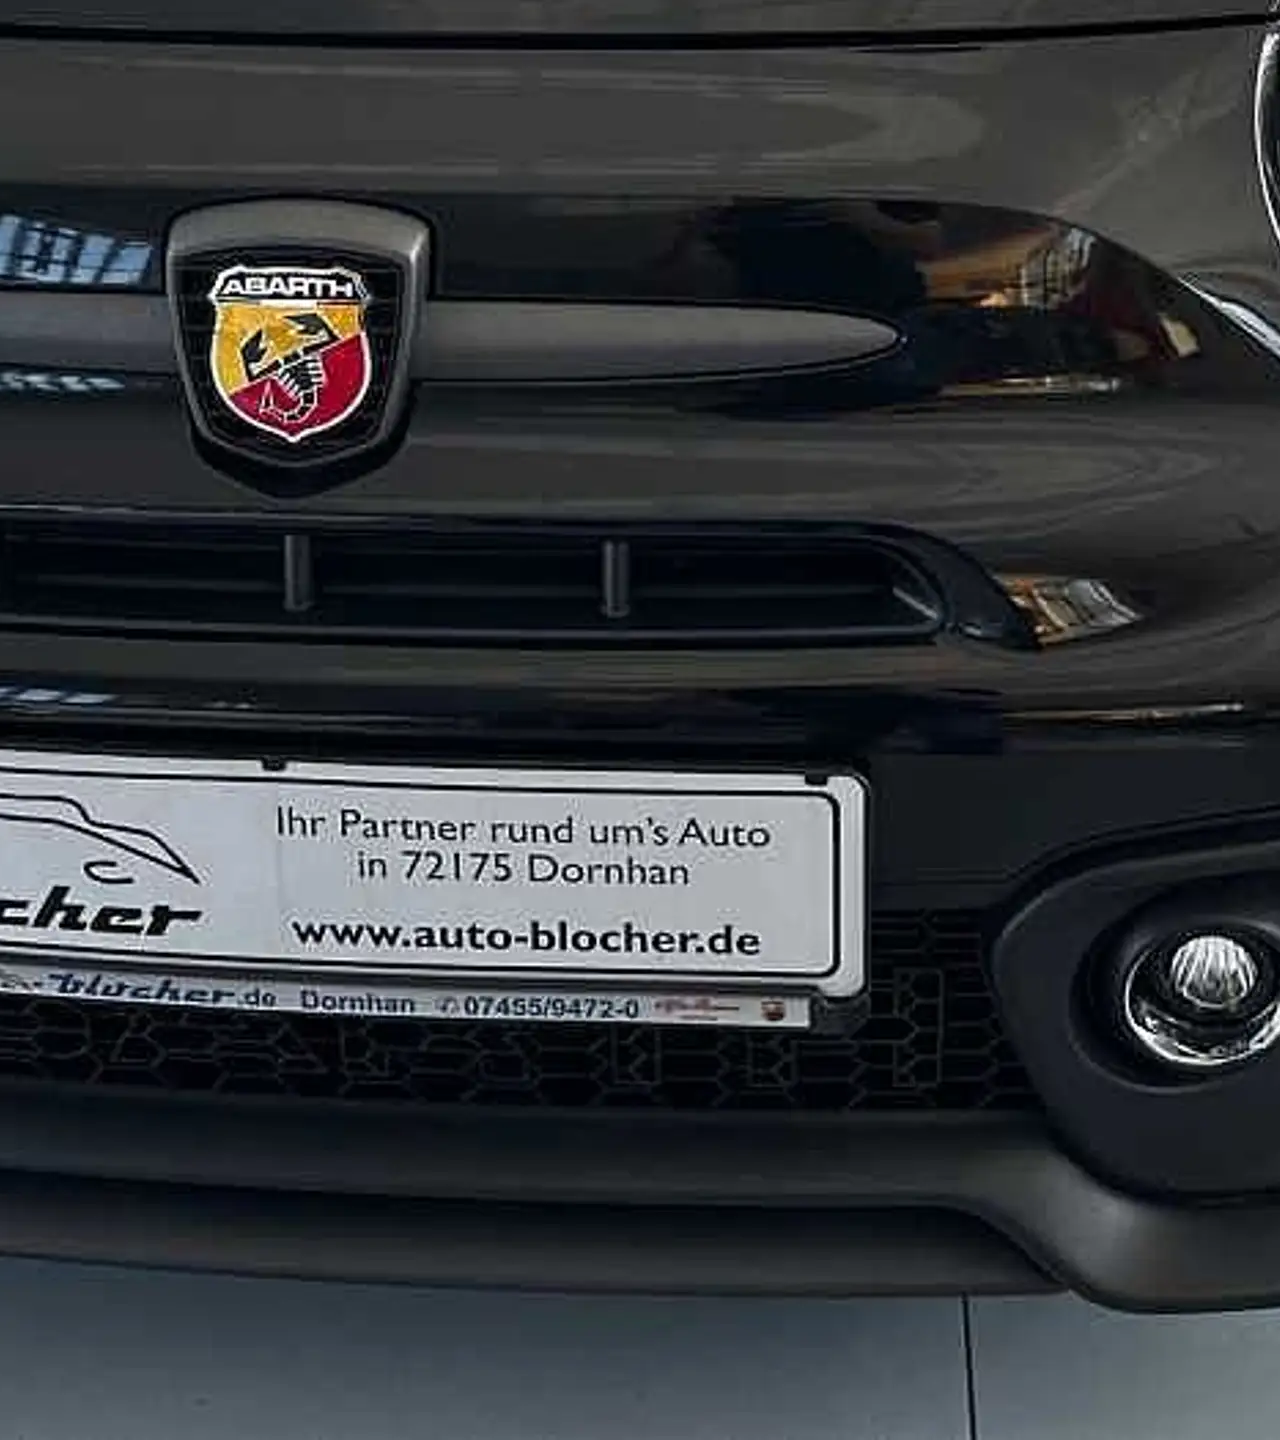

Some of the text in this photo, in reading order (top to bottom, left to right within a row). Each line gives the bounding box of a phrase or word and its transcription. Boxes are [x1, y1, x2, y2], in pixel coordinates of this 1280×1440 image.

[222, 276, 354, 298] ABARTH
[277, 806, 772, 848] Ihr Partner rund um's Auto
[357, 850, 690, 886] in 72175 Dornhan
[291, 921, 761, 956] www.auto-blocher.de
[300, 989, 416, 1014] Dornhan
[463, 995, 639, 1020] 07455/9472-0
